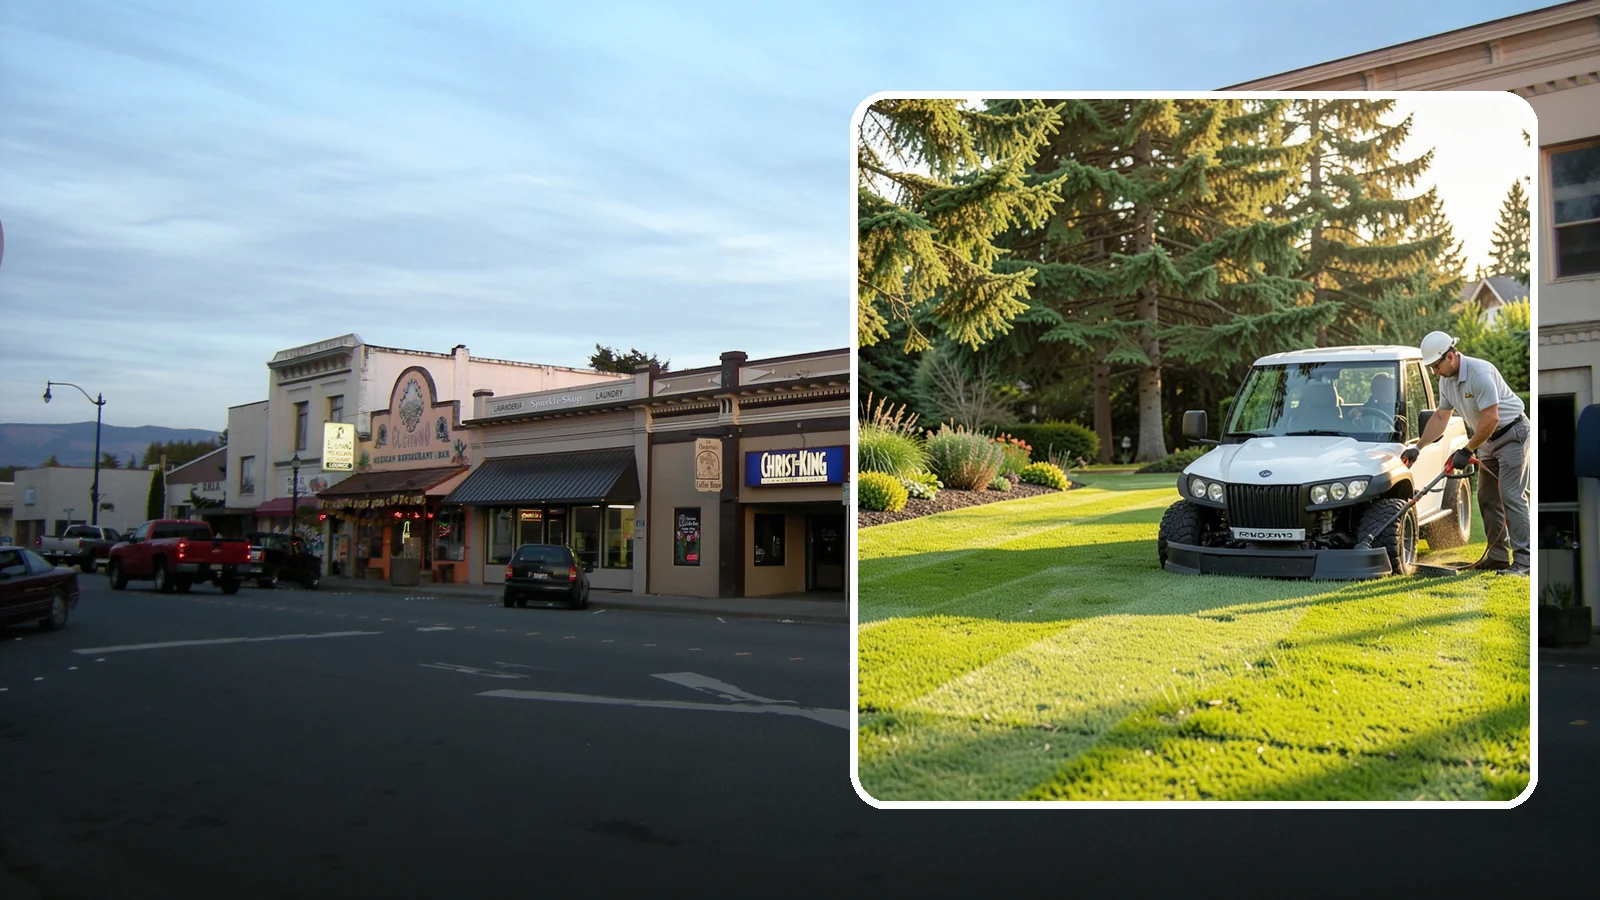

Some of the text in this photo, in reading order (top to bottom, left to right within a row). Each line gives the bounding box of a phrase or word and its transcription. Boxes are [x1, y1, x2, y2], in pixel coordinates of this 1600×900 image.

[595, 389, 624, 399] LAUNDRY
[561, 395, 582, 404] Shop
[493, 403, 522, 412] LAVANDERIA
[373, 455, 396, 464] MEXICAN
[397, 451, 434, 462] RESTAURANT
[438, 450, 450, 458] BAR
[761, 450, 827, 478] CHRIST KING
